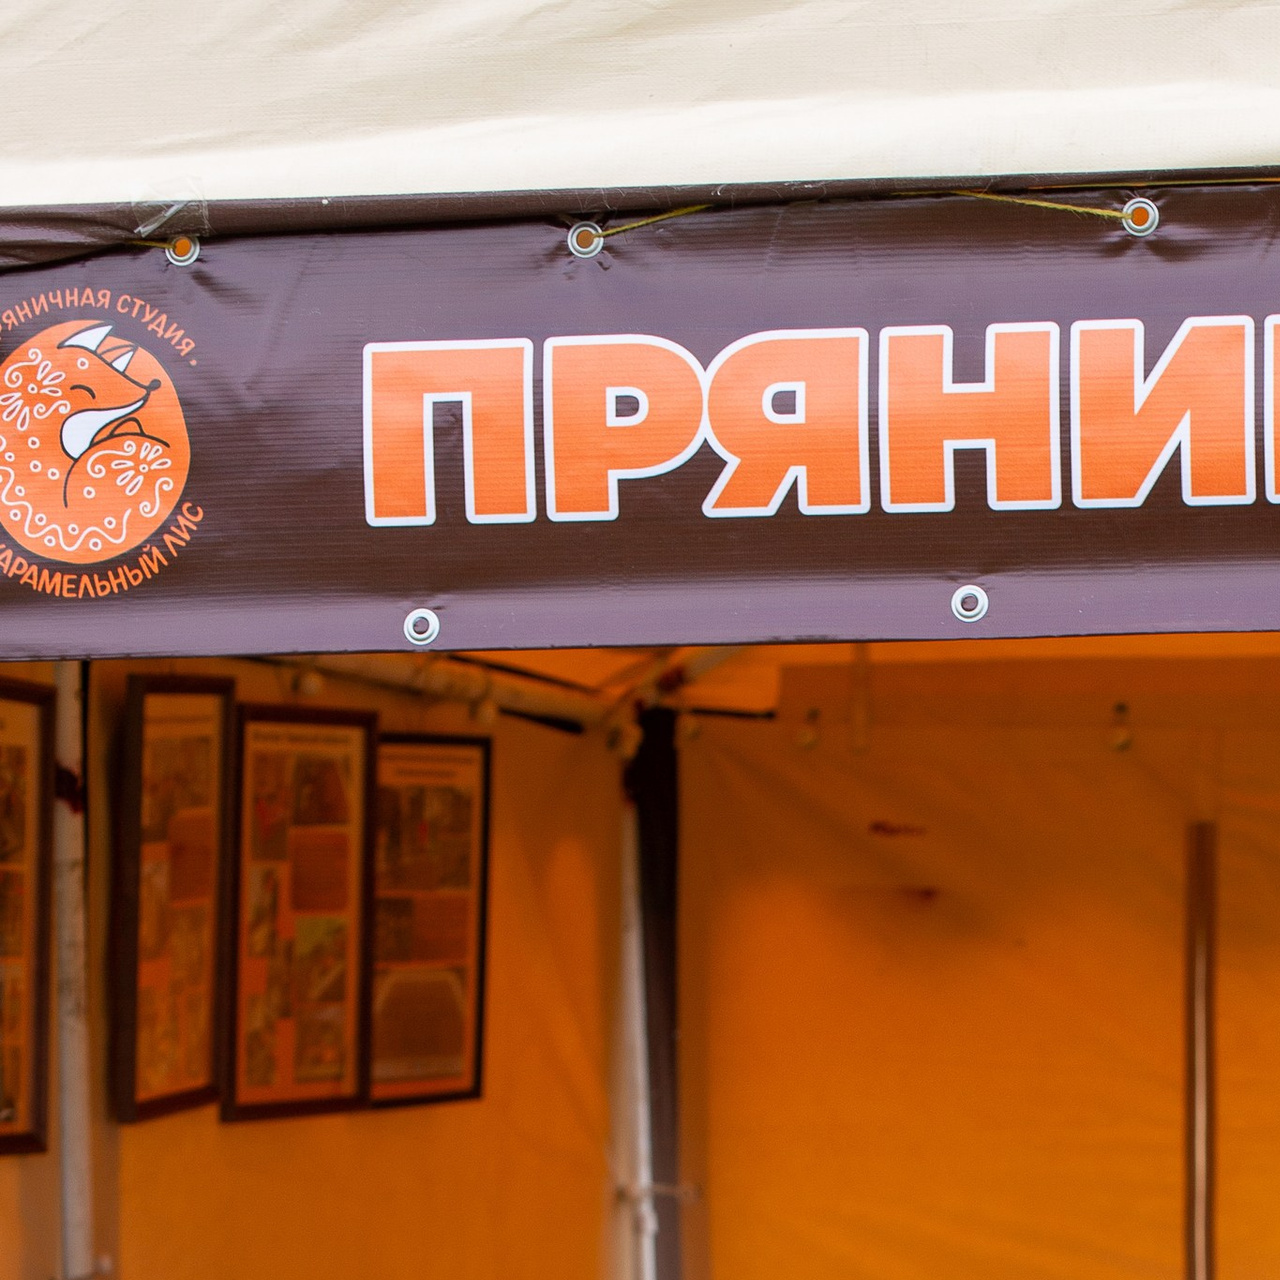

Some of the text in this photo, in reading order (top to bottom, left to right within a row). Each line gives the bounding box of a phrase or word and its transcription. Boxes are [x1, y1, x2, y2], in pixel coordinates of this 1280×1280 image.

[0, 287, 196, 357] ЯНИЧНАЯ СТУДИЯ
[0, 501, 204, 599] АРАМЕЛЬНЫЙ ЛИС
